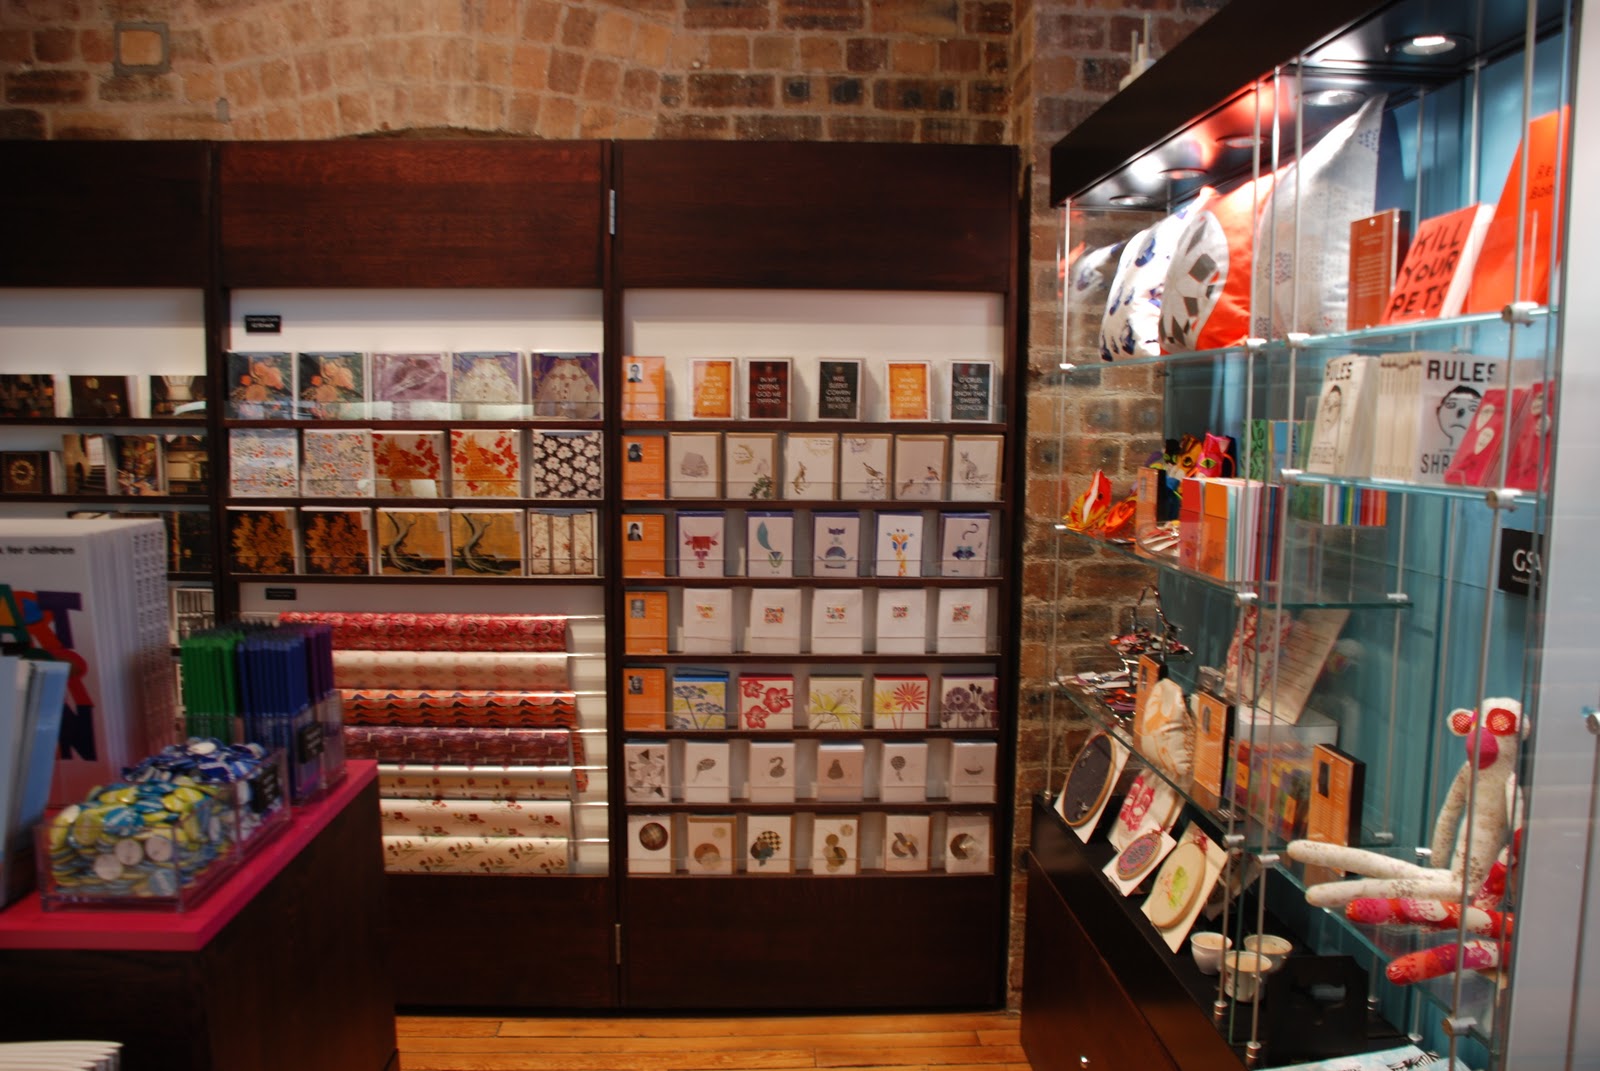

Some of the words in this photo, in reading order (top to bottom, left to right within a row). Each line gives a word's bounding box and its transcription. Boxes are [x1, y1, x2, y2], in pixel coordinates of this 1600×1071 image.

[1413, 220, 1465, 258] KILL
[1402, 250, 1459, 289] YOUR
[1387, 281, 1451, 321] PETS
[28, 545, 76, 555] children
